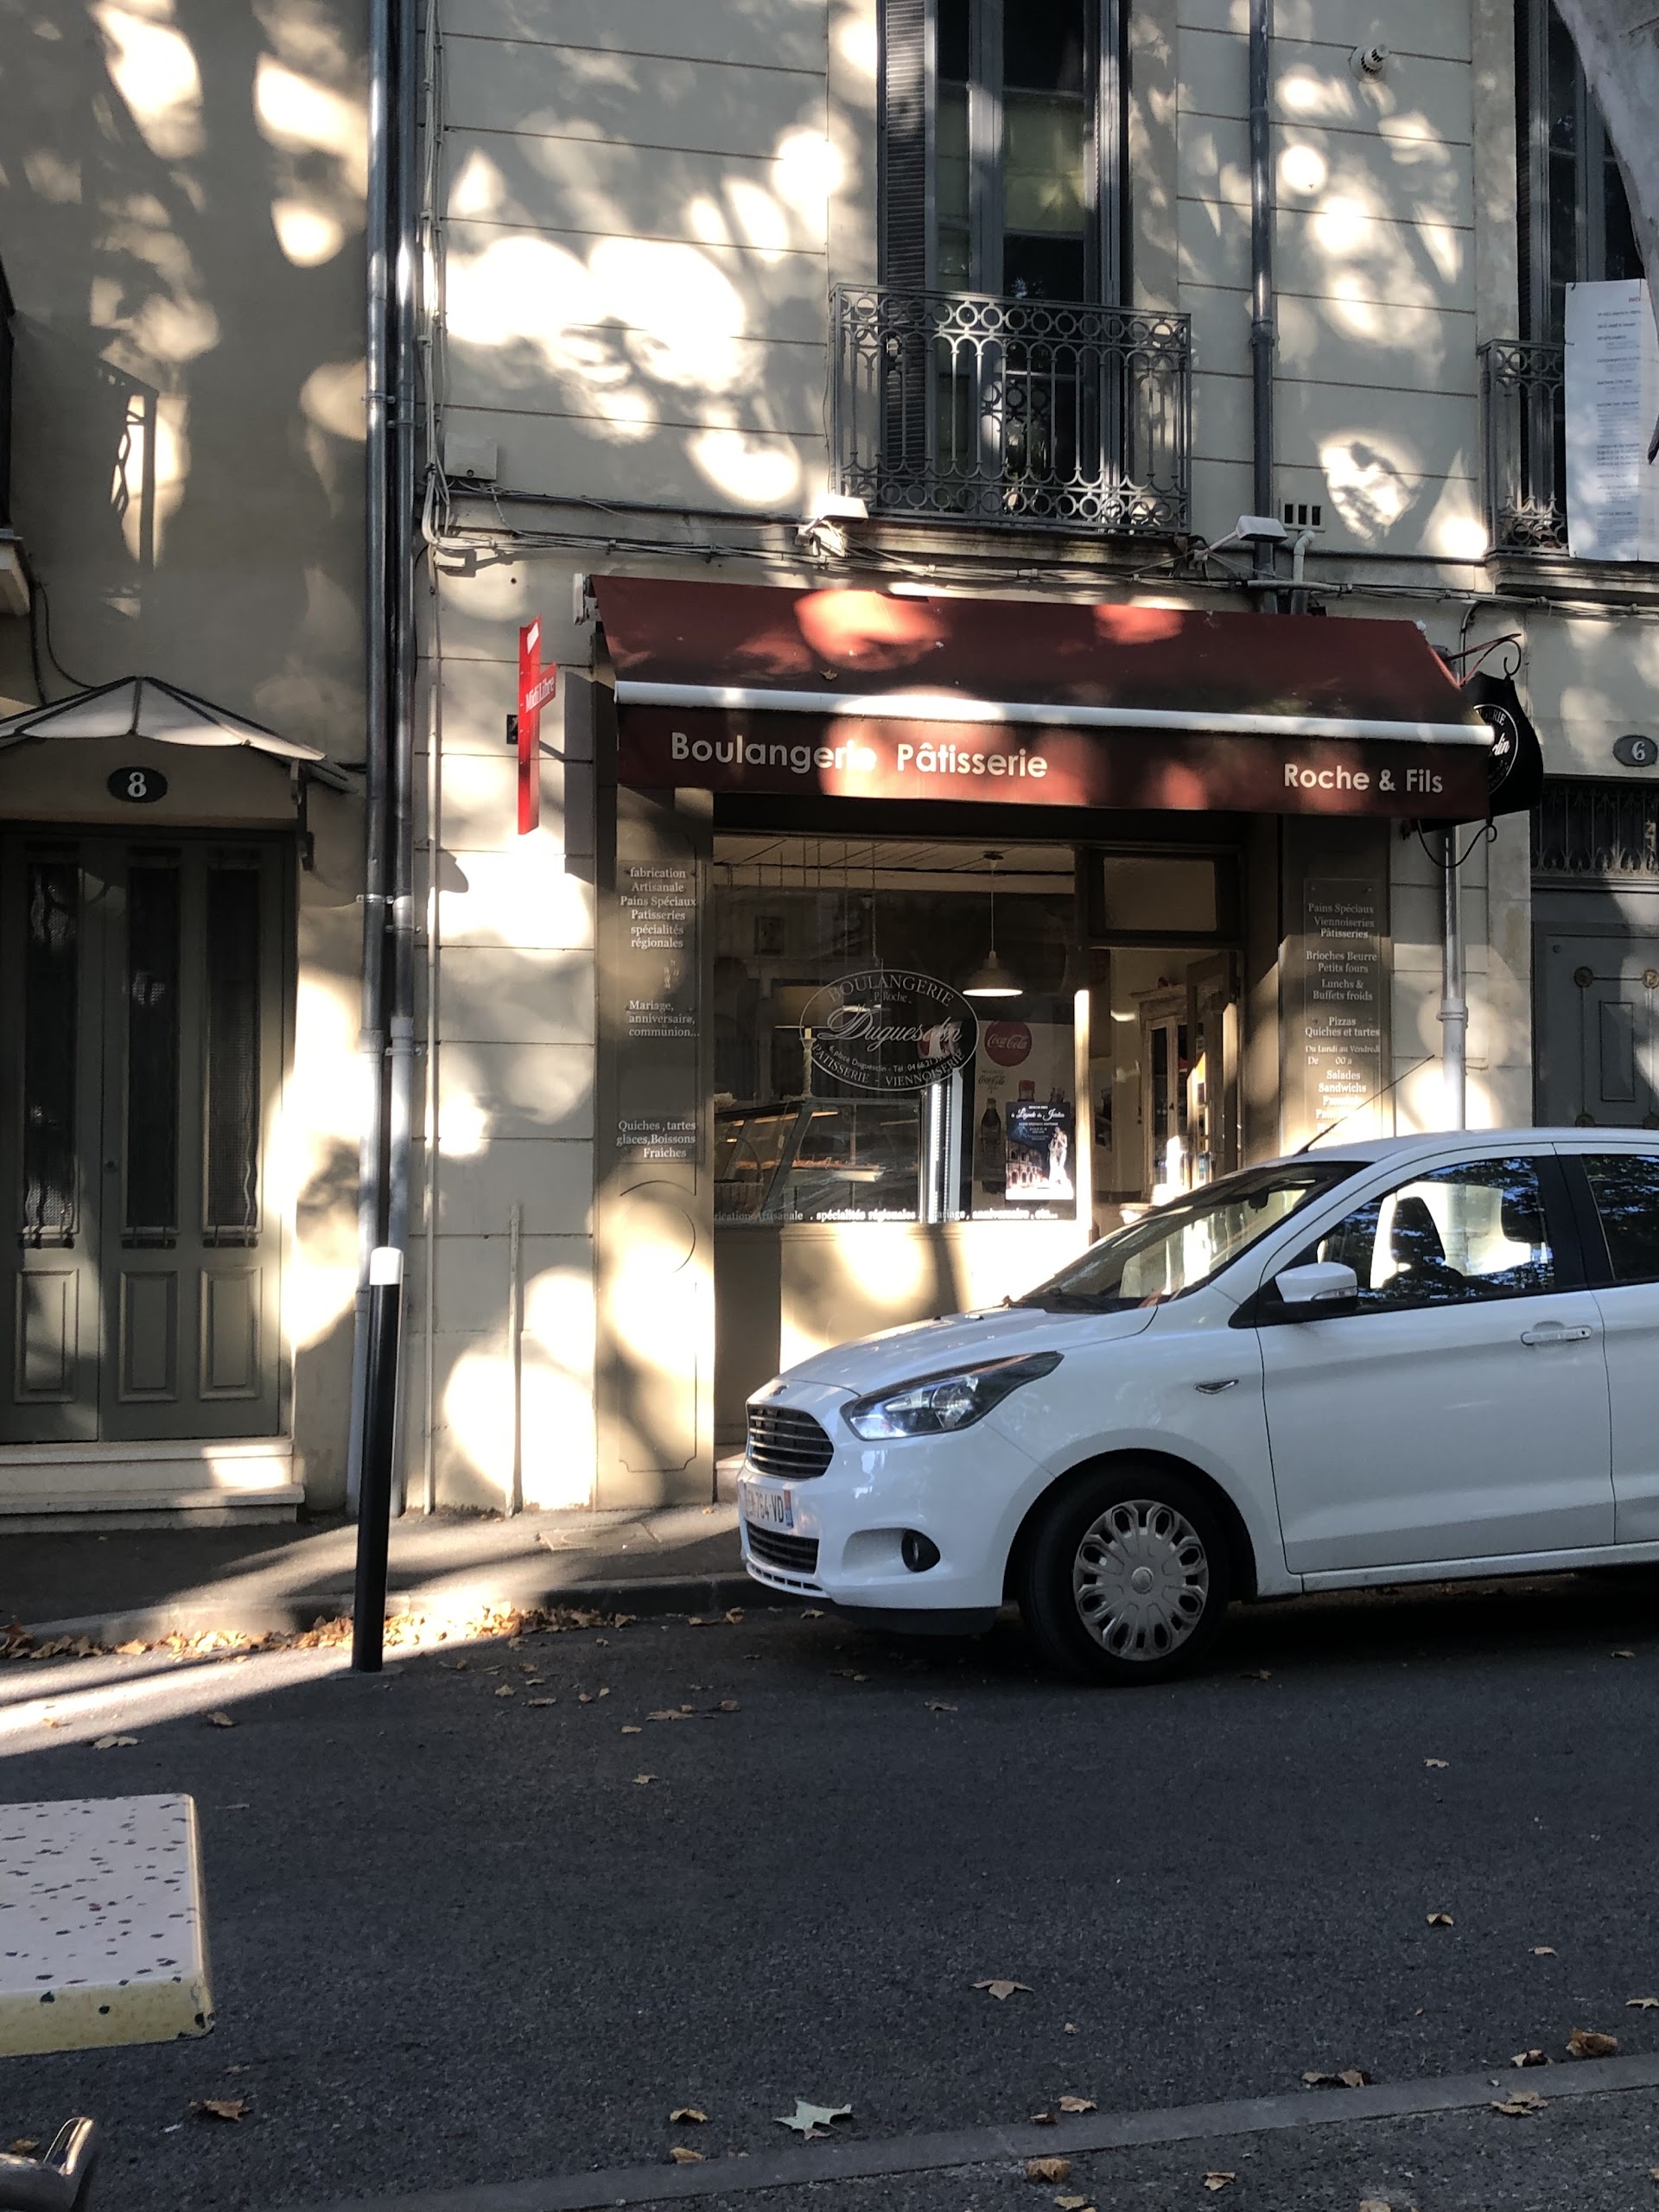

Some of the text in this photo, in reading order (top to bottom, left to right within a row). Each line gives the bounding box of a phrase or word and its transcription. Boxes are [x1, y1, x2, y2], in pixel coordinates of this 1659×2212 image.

[671, 732, 1048, 779] Boulangerie Pâtisserie
[1631, 741, 1646, 761] 6
[1284, 763, 1444, 793] Roche & Fils
[127, 772, 147, 798] 8
[630, 867, 687, 879] fabrication
[632, 881, 685, 893] Artisanale
[620, 895, 696, 908] Pains Spéciaux
[1307, 903, 1375, 915] Pains Spéciaux
[1314, 916, 1376, 927] Viennoiseries
[630, 924, 684, 937] spécialités
[631, 937, 684, 950] régionales
[1306, 950, 1377, 962] Brioches Beurre
[1318, 963, 1369, 973] Petits fours
[1321, 978, 1364, 990] Lunchs &
[827, 974, 955, 1008] BOULANGERIE
[882, 991, 908, 1002] Roche
[1313, 990, 1373, 1001] Buffets froids
[1329, 1016, 1357, 1027] Pizzas
[1305, 1027, 1380, 1038] Quiches et tartes
[1306, 1045, 1316, 1053] Du
[1318, 1045, 1338, 1053] Lundi
[1307, 1056, 1319, 1065] De
[885, 1048, 965, 1087] VIENNOISERIE
[1326, 1070, 1361, 1080] Salades
[1318, 1082, 1367, 1093] Sandwichs
[666, 1121, 696, 1131] tartes
